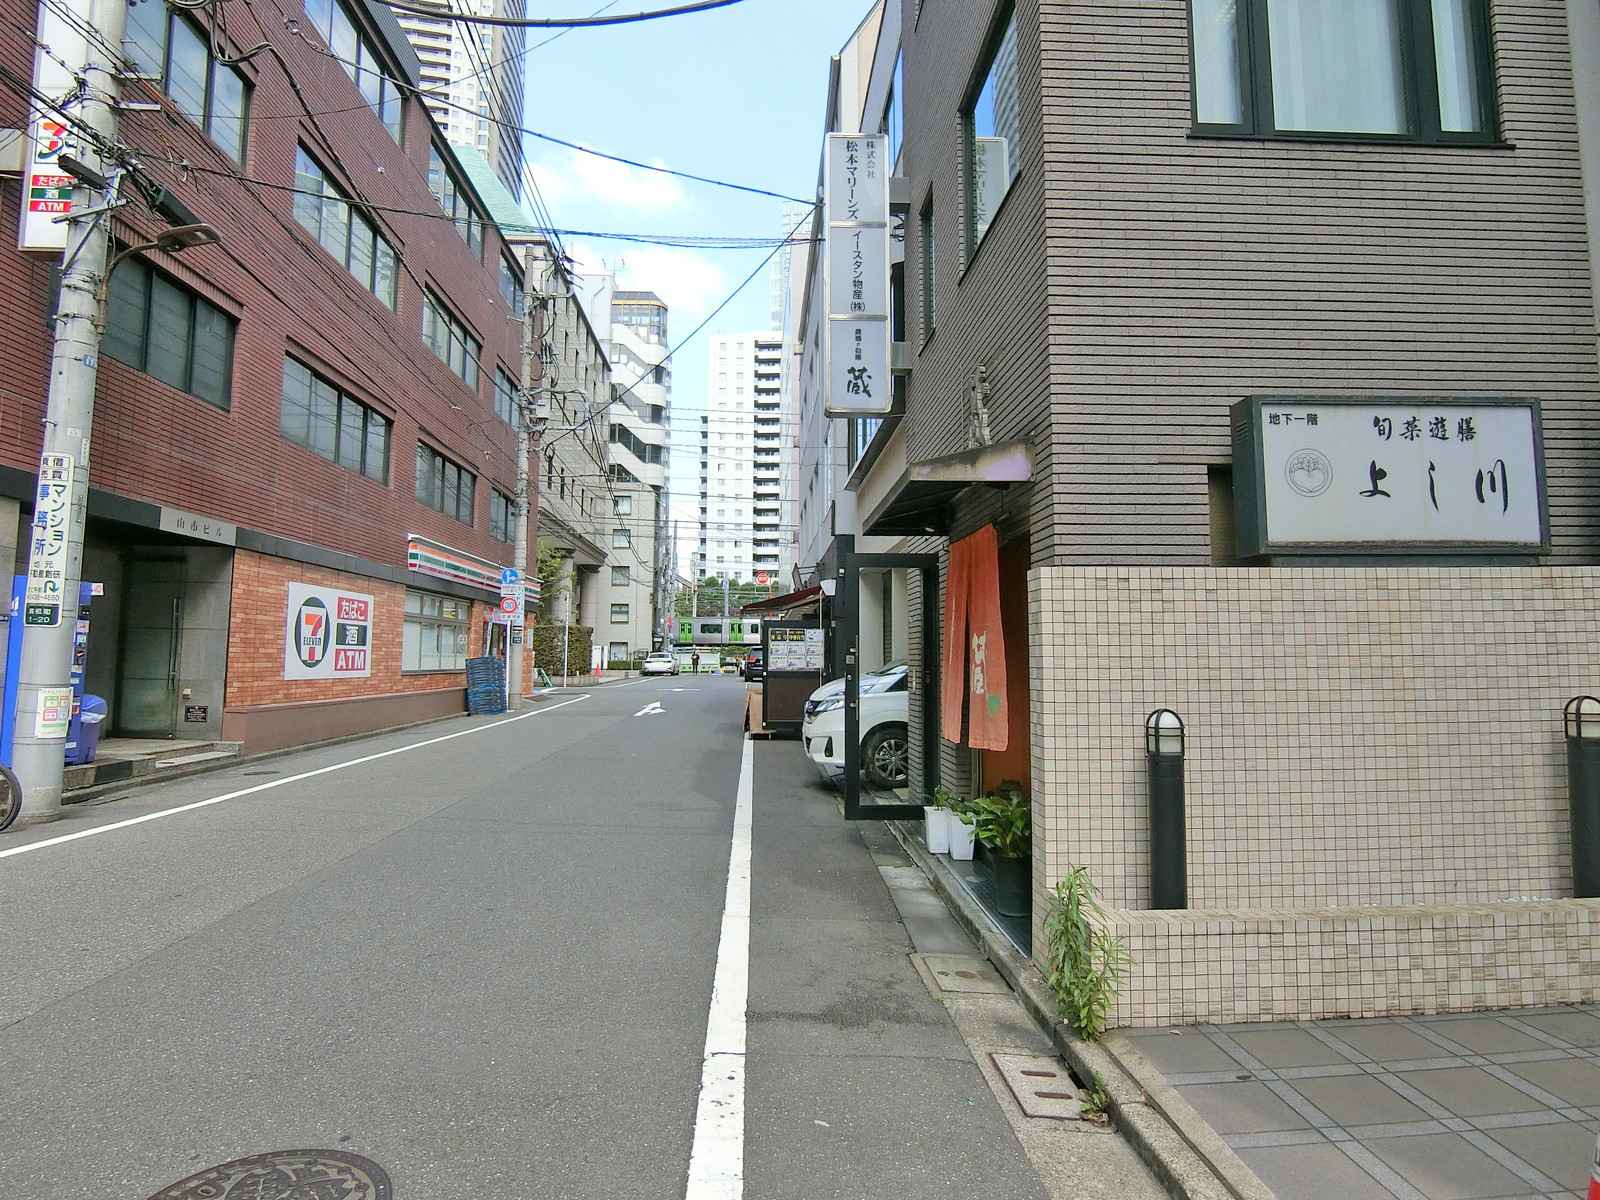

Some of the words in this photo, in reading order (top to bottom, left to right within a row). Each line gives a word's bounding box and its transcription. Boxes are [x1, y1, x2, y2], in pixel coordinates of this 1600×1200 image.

[866, 140, 876, 179] 株式会社
[846, 140, 859, 220] 松本マリーンズ
[45, 189, 60, 199] 酒
[38, 202, 64, 211] ATM
[850, 230, 866, 312] イースタン物産(株)
[1268, 412, 1319, 427] 地下一階
[1372, 415, 1477, 442] 旬菜遊膳
[34, 484, 50, 556] 事務所
[47, 484, 67, 556] マンション
[177, 517, 222, 537] 山市ビル
[341, 600, 365, 620] たばこ
[504, 601, 515, 610] 30
[345, 625, 359, 644] 酒
[337, 650, 365, 669] ATM
